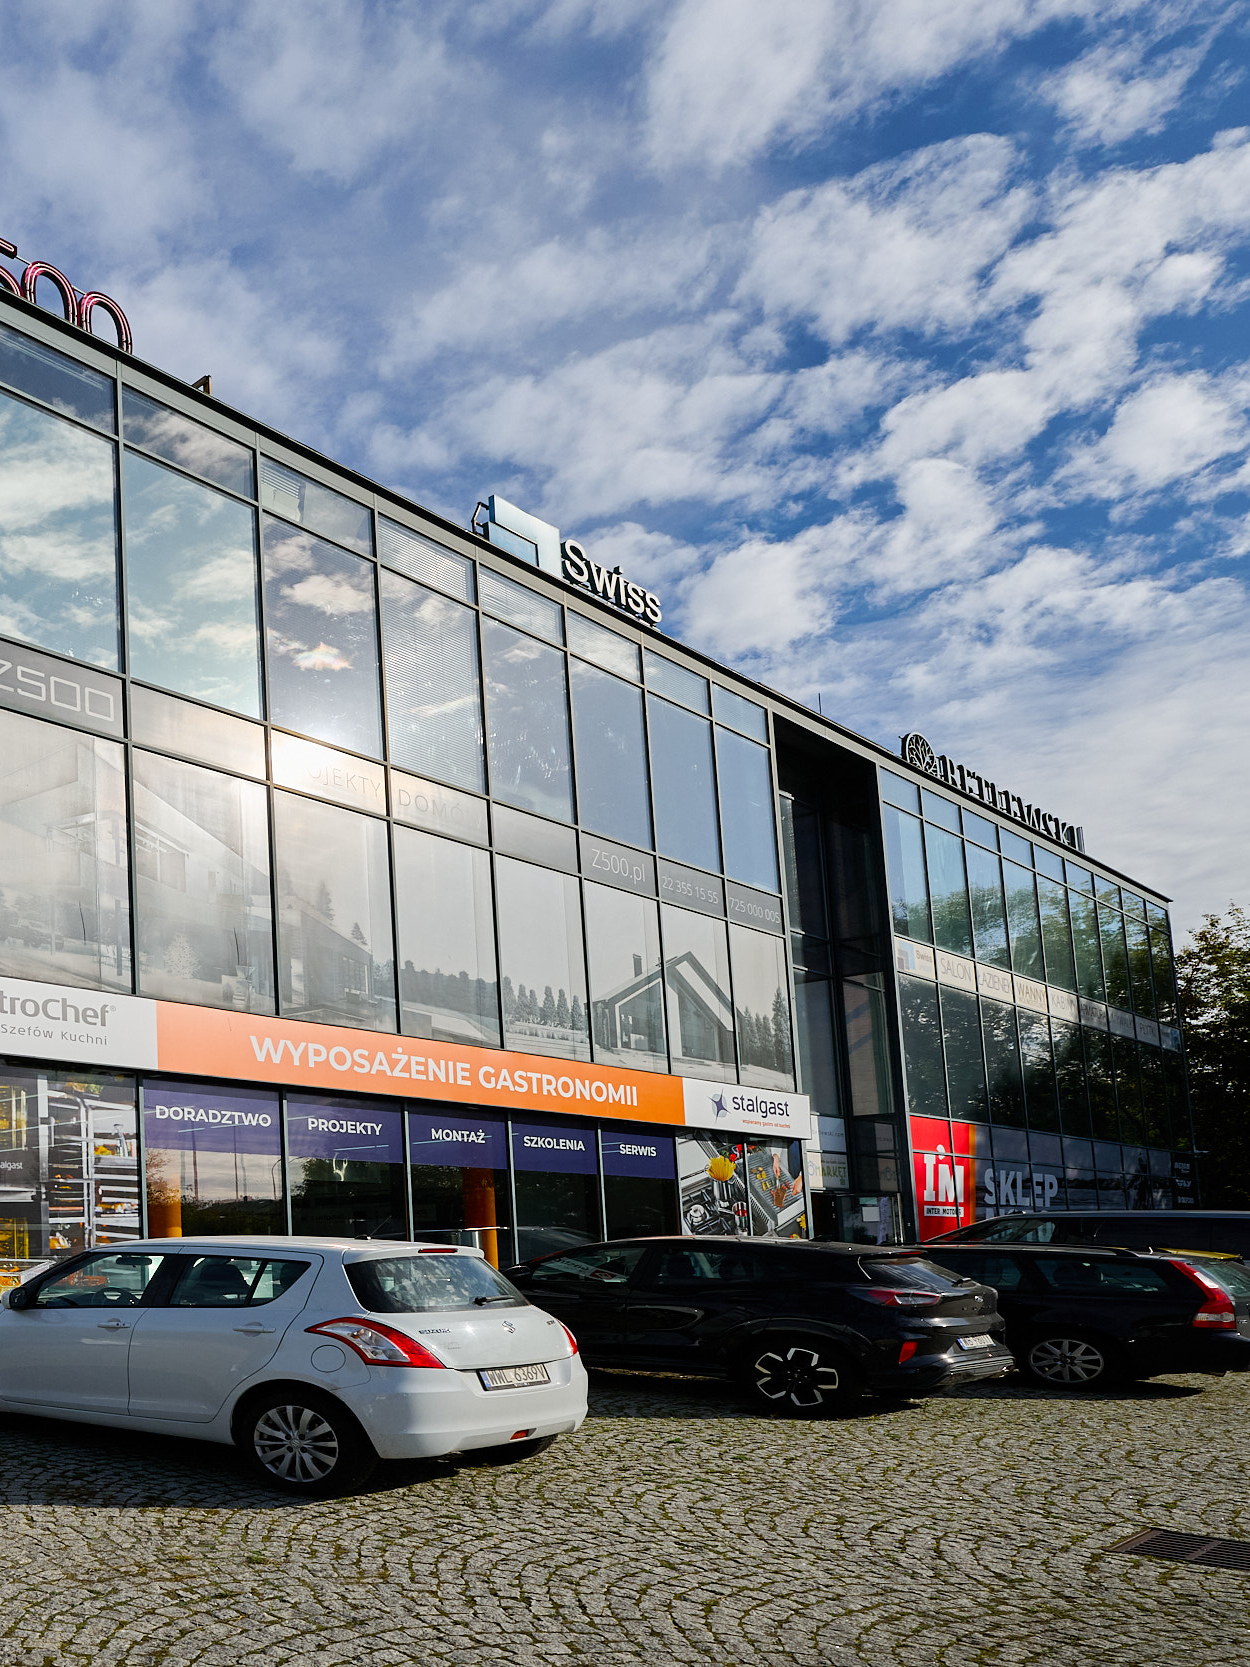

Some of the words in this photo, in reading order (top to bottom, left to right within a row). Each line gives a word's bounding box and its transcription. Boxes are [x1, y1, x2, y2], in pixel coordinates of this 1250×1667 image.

[561, 539, 663, 624] Swiss
[591, 848, 646, 885] Z500.pl
[662, 875, 674, 891] 22
[676, 879, 693, 896] 355
[695, 886, 706, 900] 15
[708, 890, 719, 905] 55
[729, 896, 745, 913] 725
[747, 902, 764, 918] 000
[765, 907, 781, 924] 005
[940, 957, 972, 982] SALON
[1, 1022, 54, 1039] Szefów
[61, 1031, 108, 1046] Kuchni
[249, 1035, 472, 1086] WYPOSAŻENIE
[478, 1065, 638, 1107] GASTRONOMII
[732, 1094, 790, 1119] stalgast
[155, 1105, 272, 1127] DORADZTWO
[307, 1117, 382, 1136] PROJEKTY
[431, 1128, 486, 1144] MONTAŻ
[523, 1136, 586, 1151] SZKOLENIA
[619, 1143, 657, 1157] SERWIS
[984, 1168, 1059, 1207] SKLEP
[488, 1368, 513, 1386] WWL
[514, 1365, 547, 1382] 6369V
